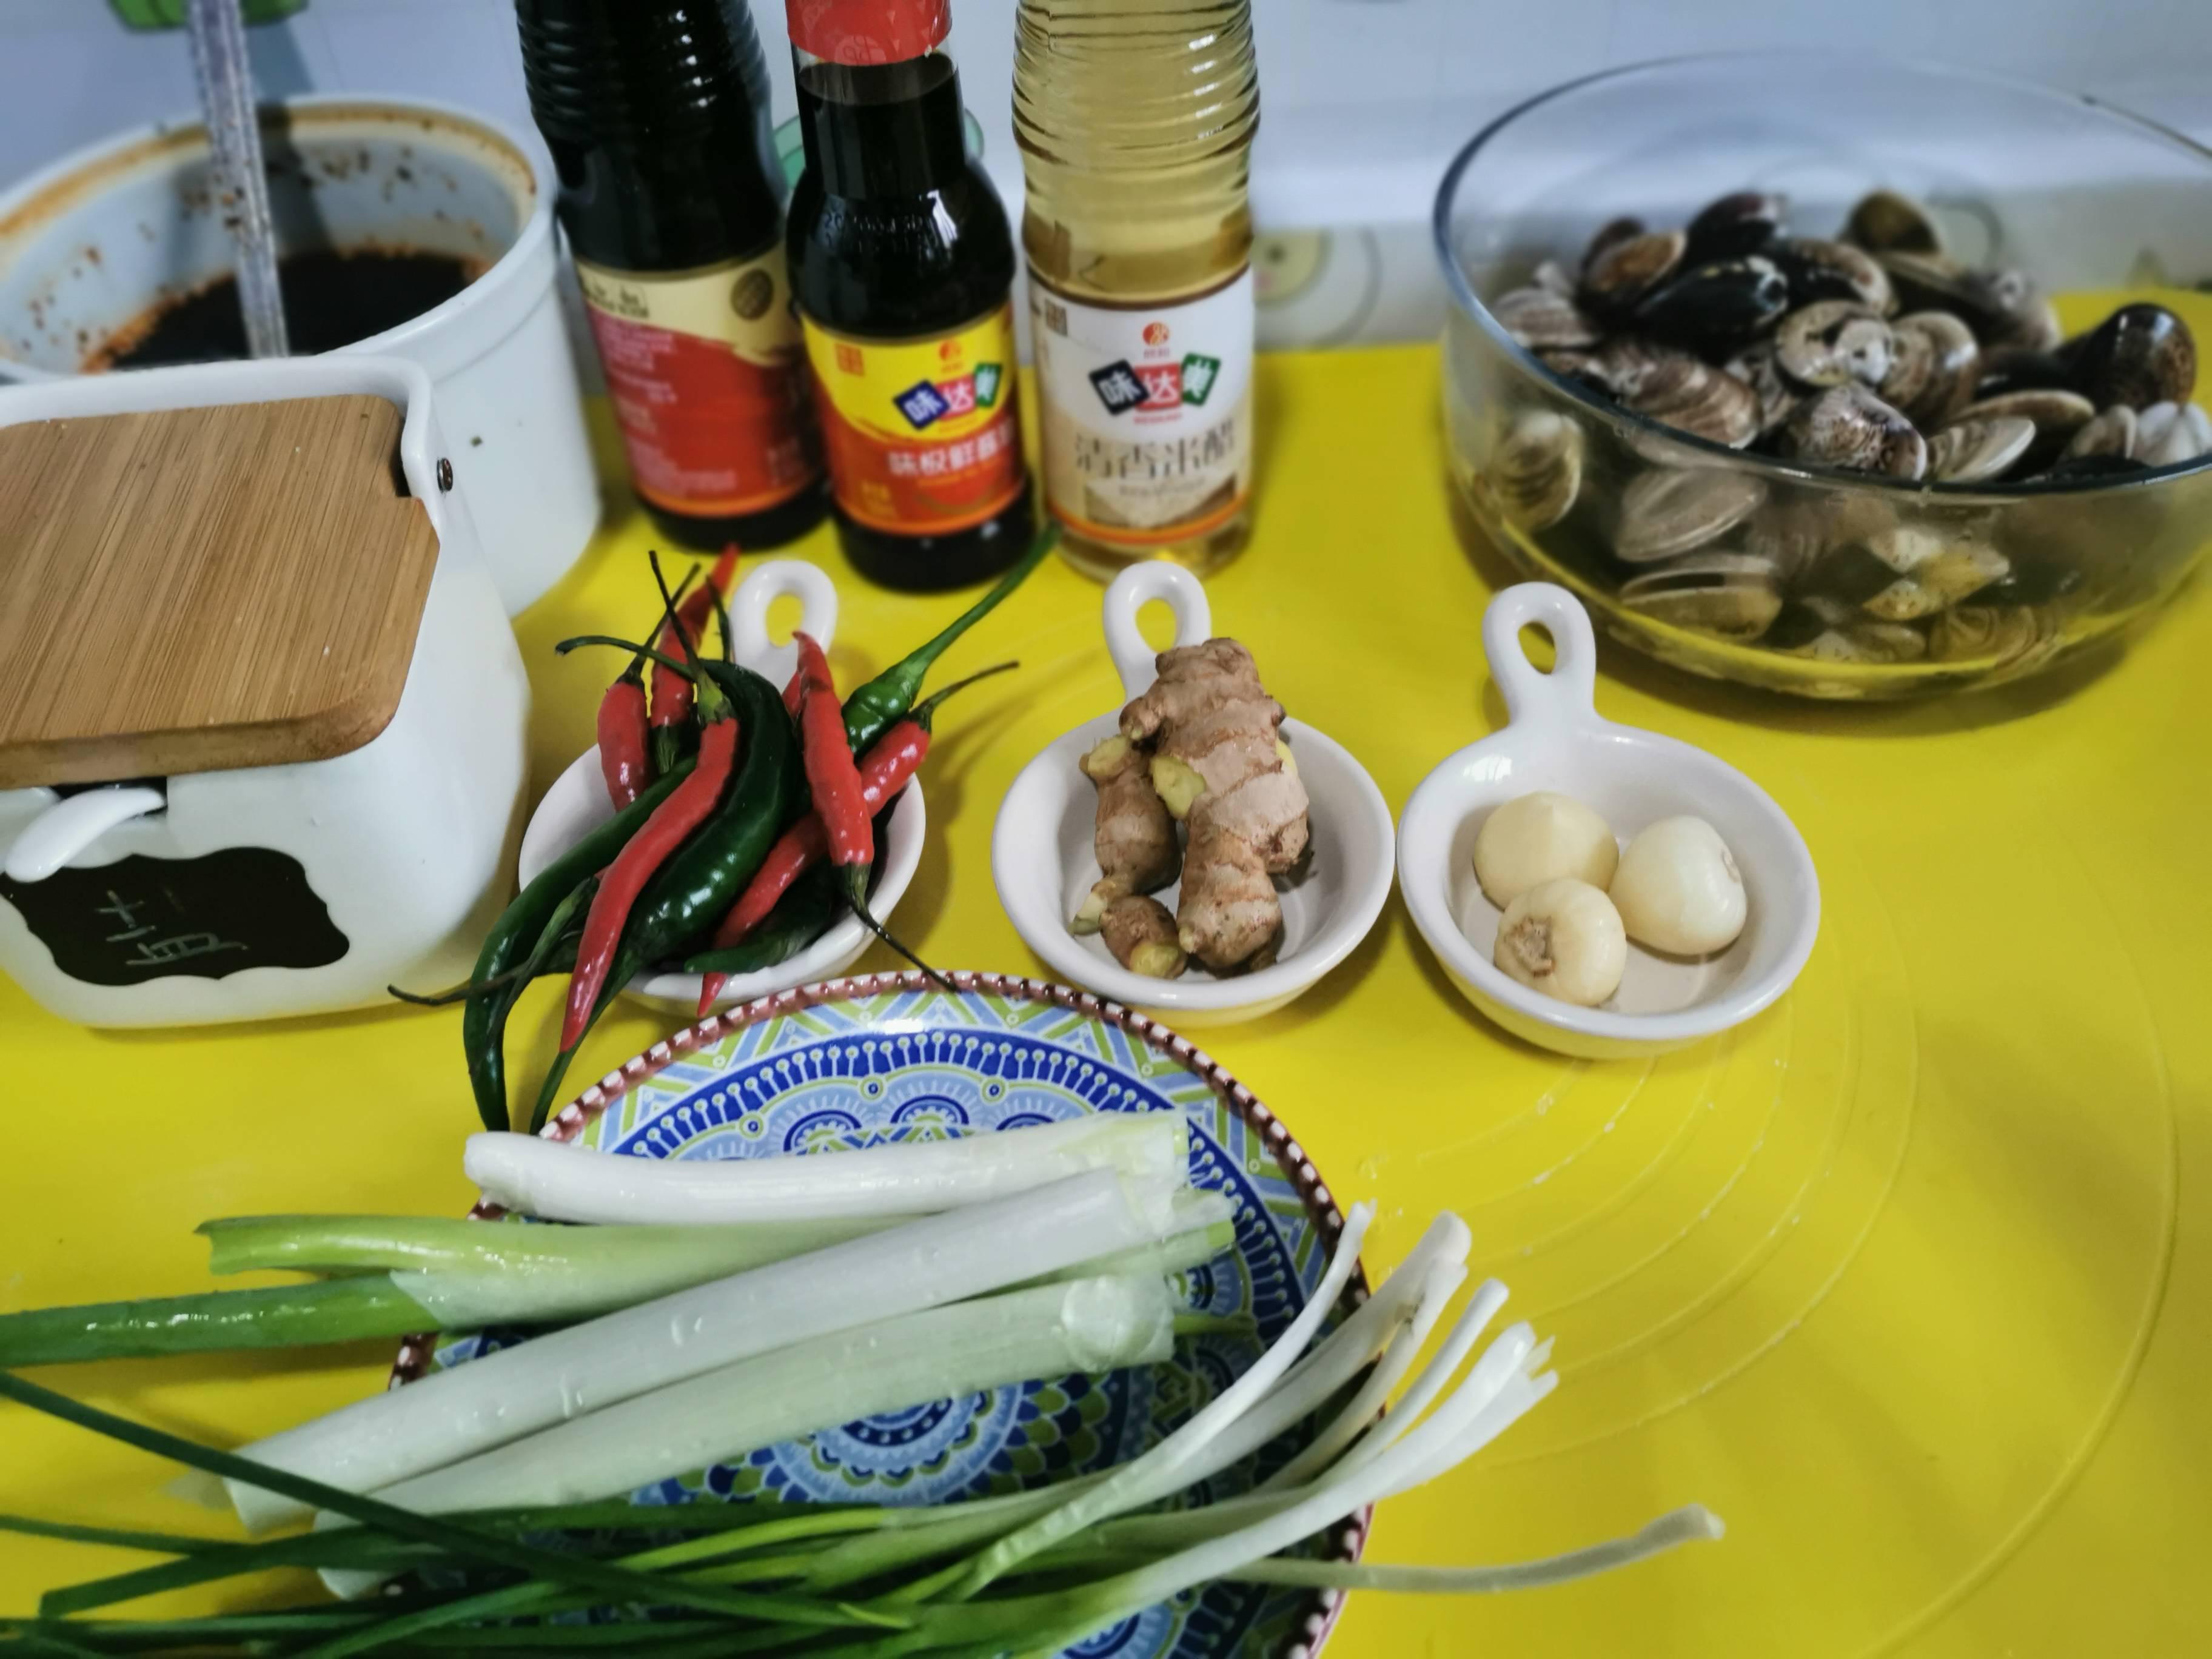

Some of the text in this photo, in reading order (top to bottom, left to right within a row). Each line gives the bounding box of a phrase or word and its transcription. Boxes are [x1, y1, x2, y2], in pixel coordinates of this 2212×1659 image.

[900, 364, 999, 424] 味达美
[1093, 358, 1216, 409] 味达美
